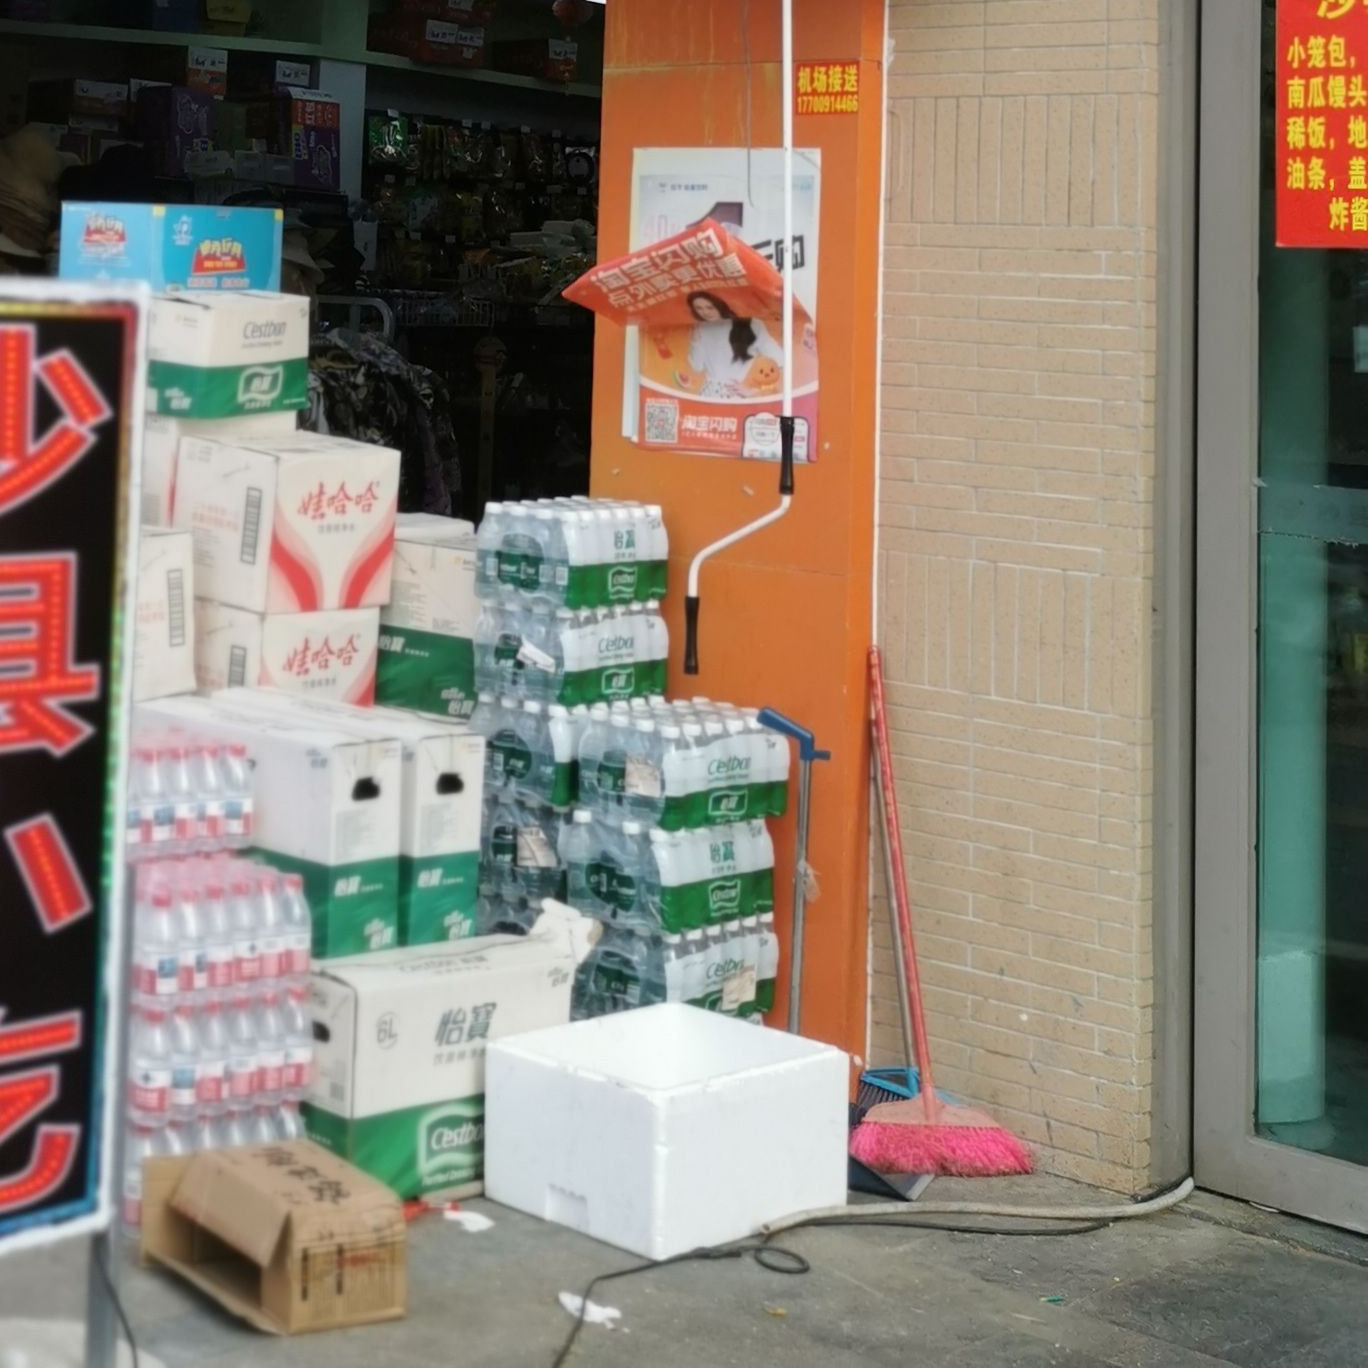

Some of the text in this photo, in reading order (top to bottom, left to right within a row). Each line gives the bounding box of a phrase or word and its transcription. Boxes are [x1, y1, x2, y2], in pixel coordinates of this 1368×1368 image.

[798, 64, 858, 94] 机场接送
[797, 94, 858, 113] 17700914466
[590, 228, 724, 292] 淘宝闪购
[607, 252, 747, 308] 点外卖更优惠
[682, 413, 738, 432] 淘宝闪购
[297, 481, 379, 521] 娃哈哈
[282, 633, 359, 677] 娃哈哈
